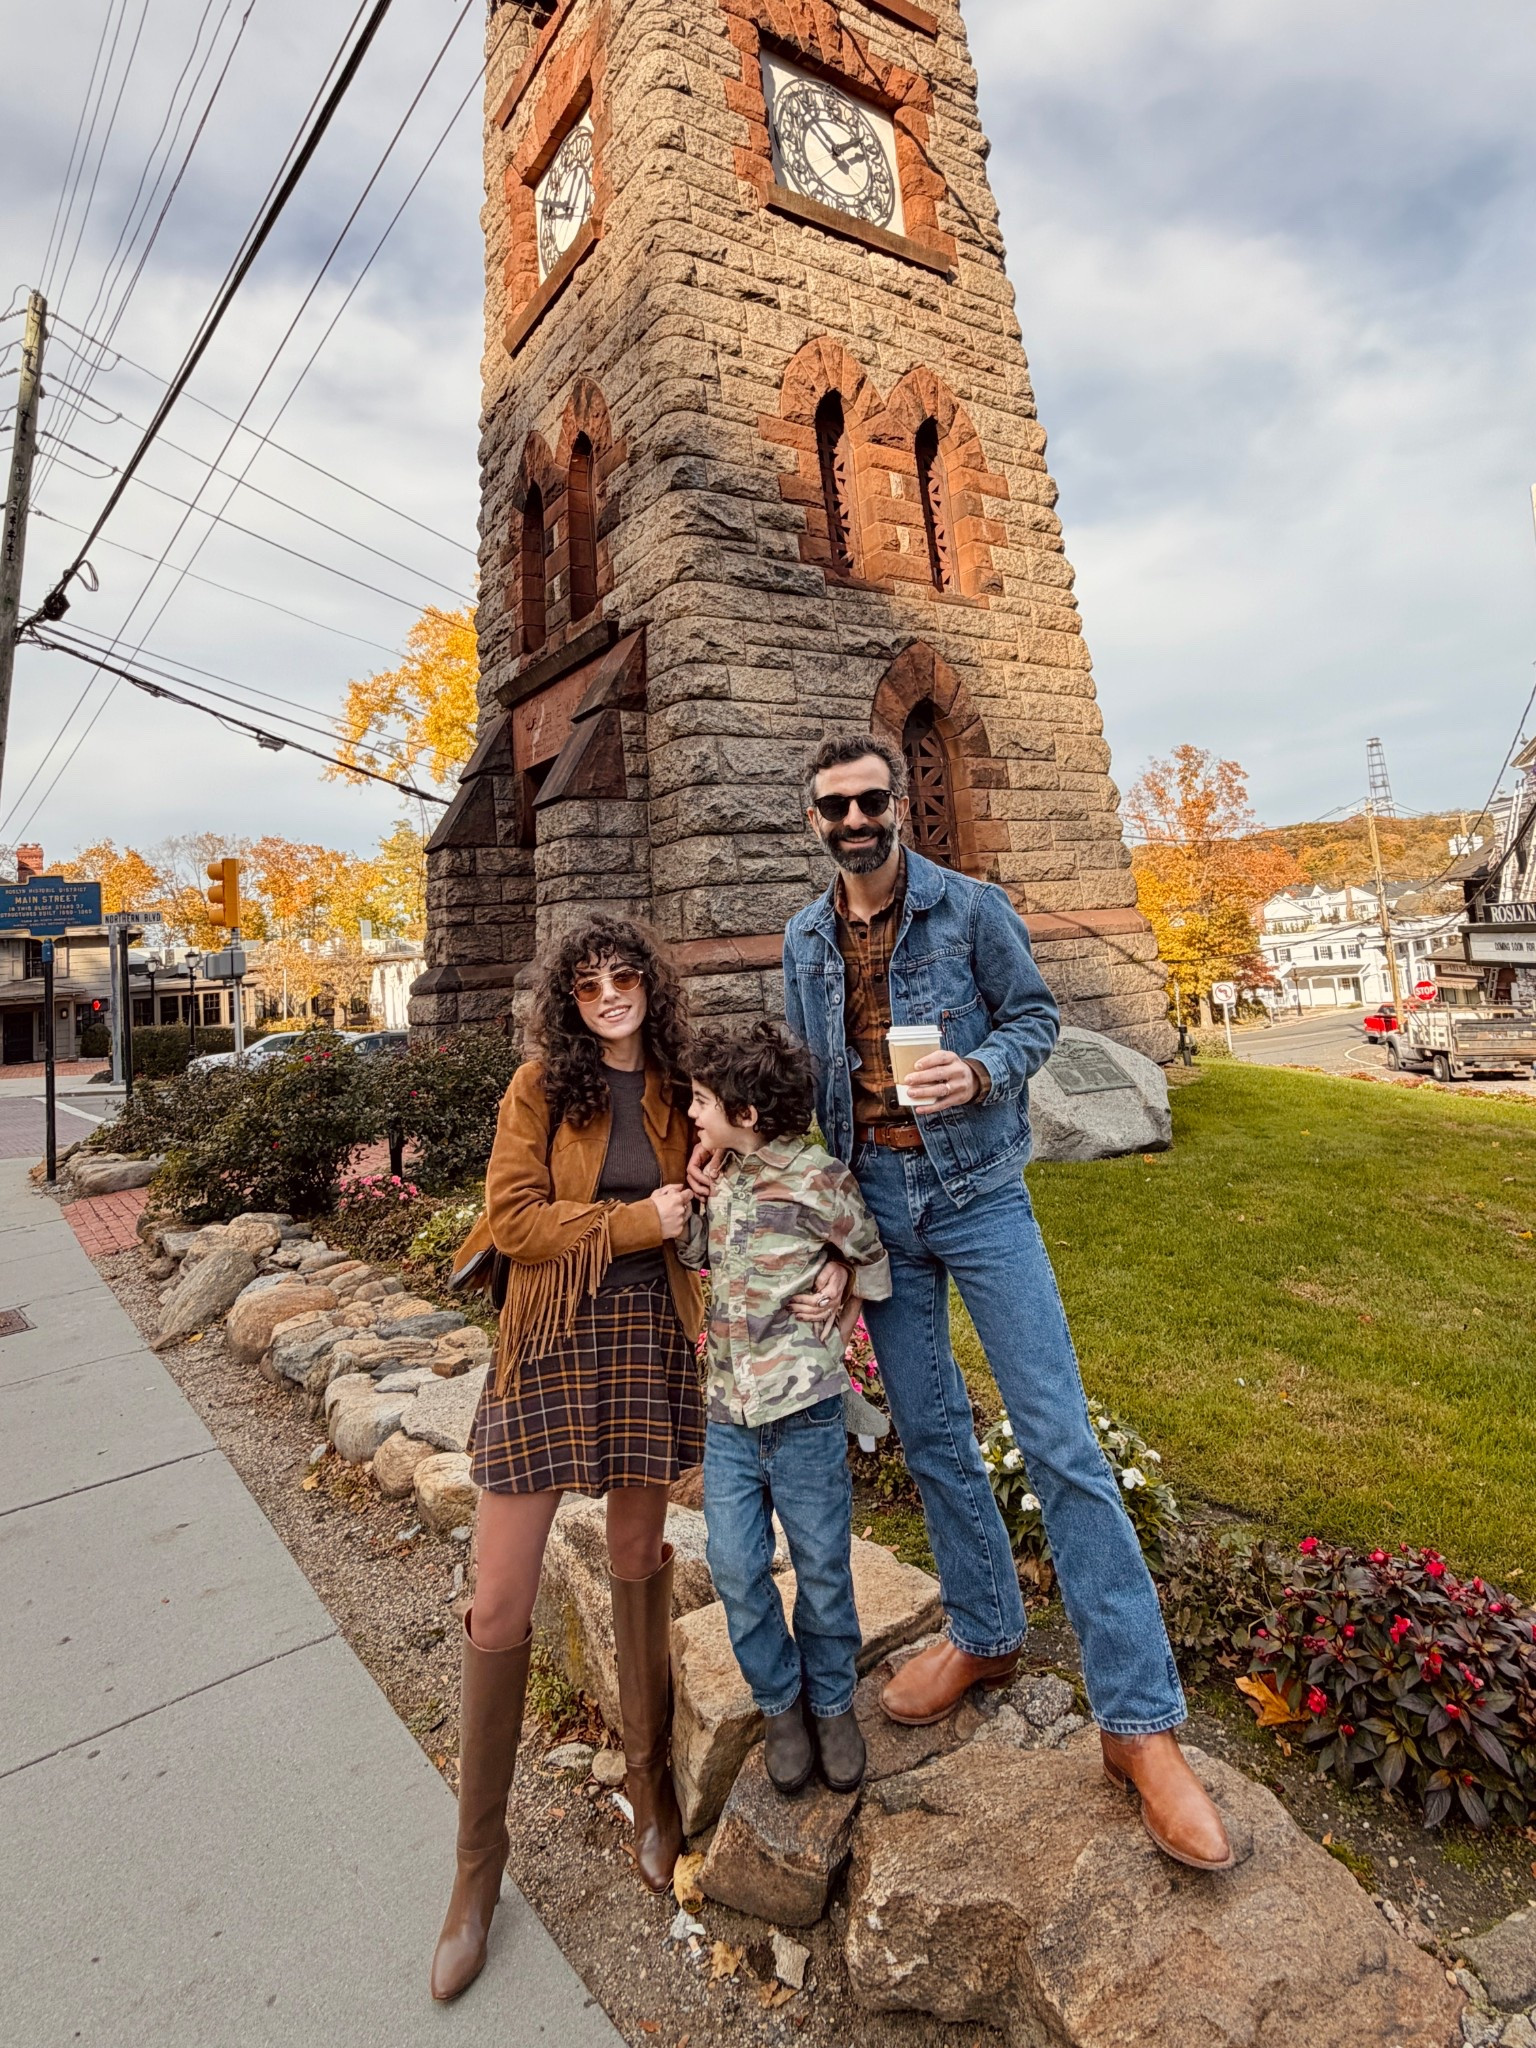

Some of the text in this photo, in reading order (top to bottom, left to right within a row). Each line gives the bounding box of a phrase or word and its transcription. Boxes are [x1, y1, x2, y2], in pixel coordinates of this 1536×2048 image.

[15, 894, 78, 904] MAIN STREET
[105, 912, 161, 923] NORTHERN BLVD
[1490, 904, 1536, 922] ROSLYN
[1415, 986, 1435, 995] STOP
